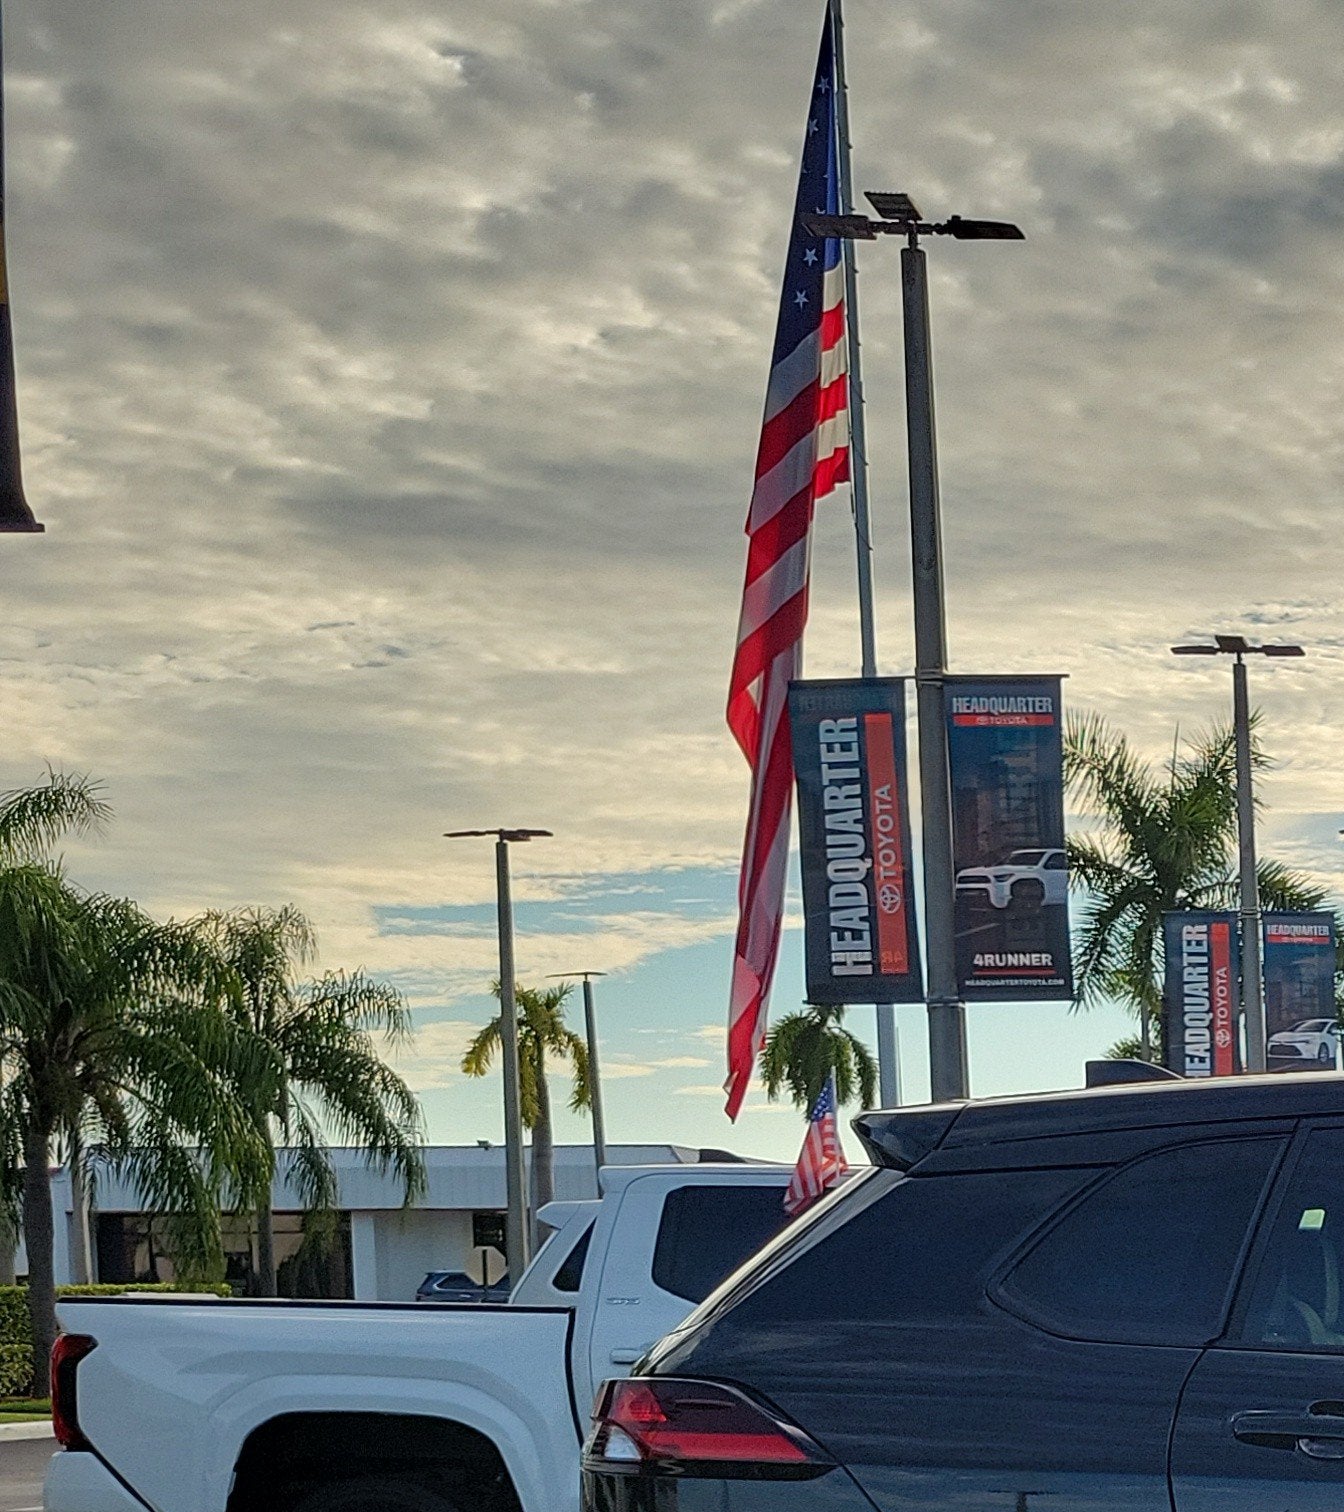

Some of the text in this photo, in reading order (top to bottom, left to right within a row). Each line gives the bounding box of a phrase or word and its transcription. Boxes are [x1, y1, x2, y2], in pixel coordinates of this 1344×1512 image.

[953, 697, 1053, 716] HEADQUARTER
[819, 717, 873, 976] HEADQUARTER
[875, 784, 898, 880] TOYOTA
[1266, 924, 1330, 937] HEADQUARTER
[973, 953, 1053, 967] 4RUNNER
[1216, 967, 1229, 1028] TOYOTA
